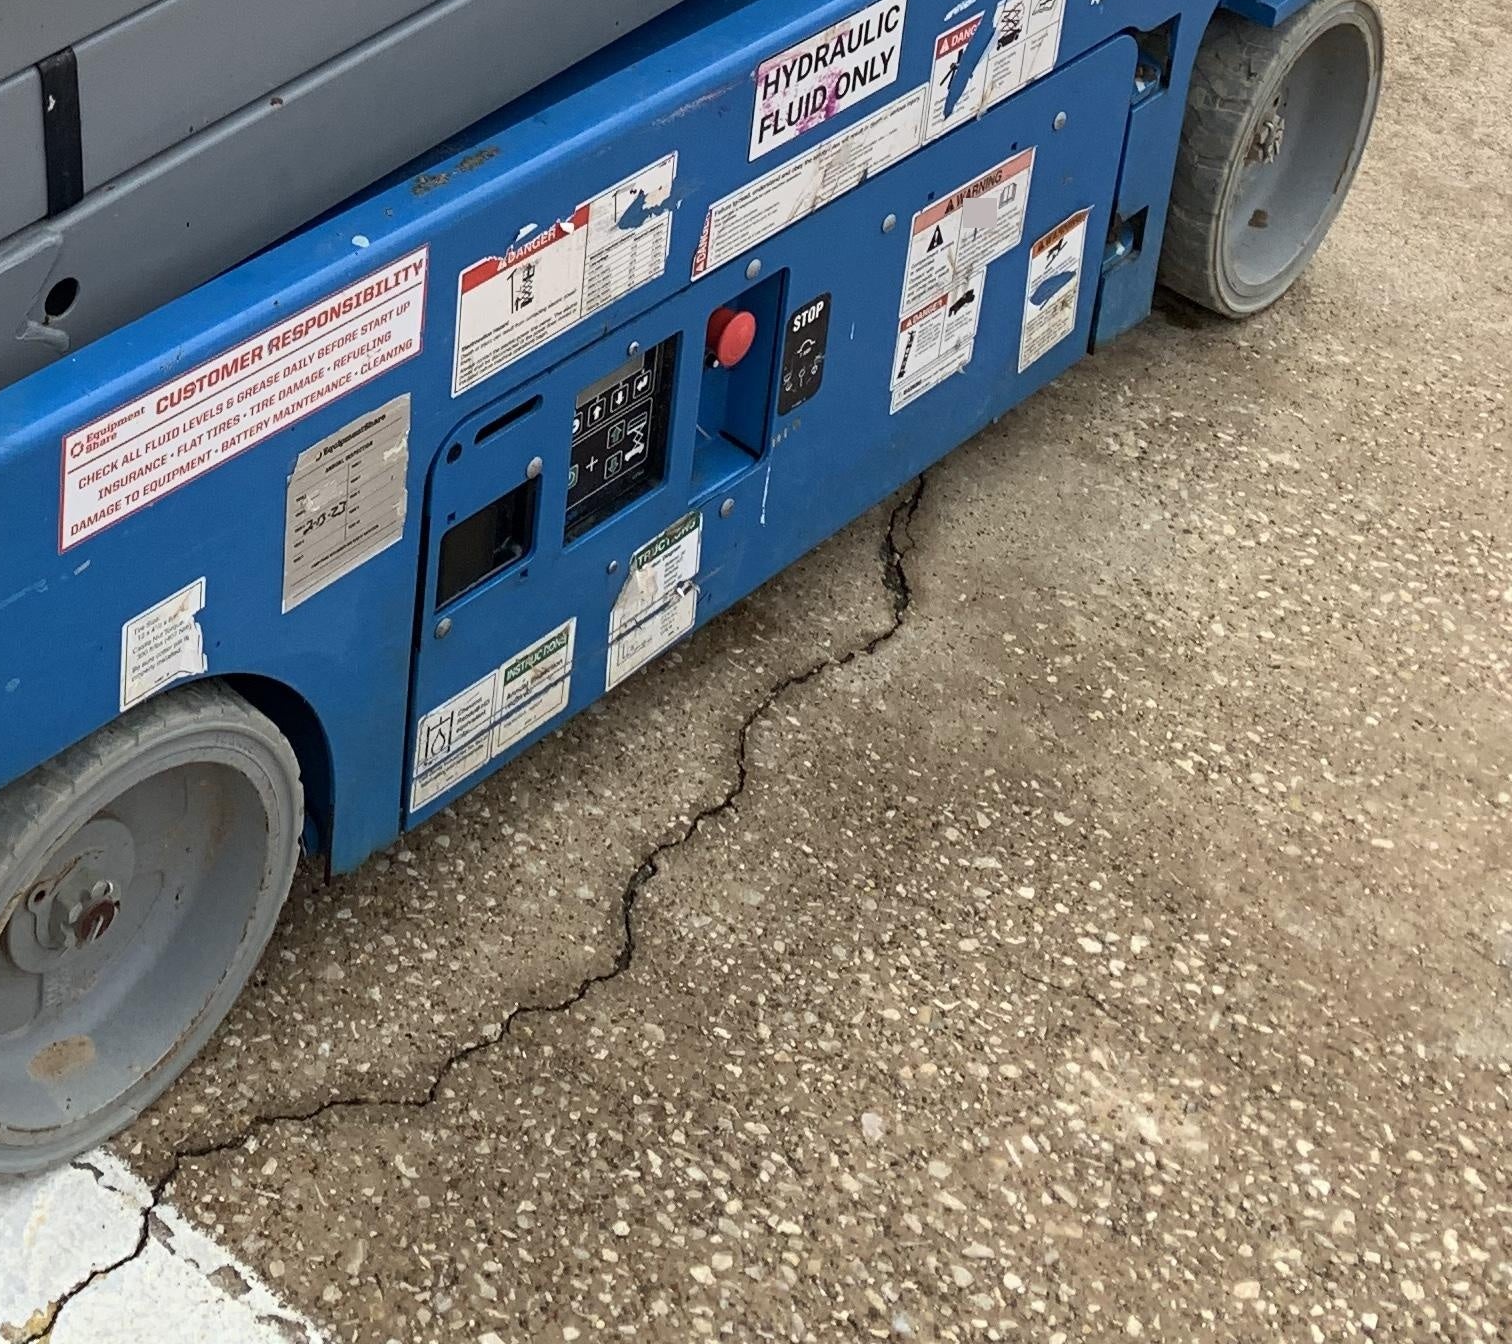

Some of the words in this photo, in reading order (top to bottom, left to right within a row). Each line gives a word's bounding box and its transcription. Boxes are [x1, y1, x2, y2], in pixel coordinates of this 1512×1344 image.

[758, 84, 826, 144] FLUID
[835, 46, 896, 100] ONLY
[762, 4, 901, 101] HYDRAULIC
[508, 227, 557, 263] DANGER
[86, 406, 145, 443] Equipment
[155, 344, 263, 415] CUSTOMER
[269, 258, 423, 355] RESPONSIBILITY
[792, 300, 824, 332] STOP
[70, 499, 121, 536] DAMAGE
[124, 490, 139, 505] TO
[143, 449, 212, 496] EQUIPMENT
[221, 417, 270, 452] BATTERY
[272, 372, 352, 424] MAINTENANCE
[360, 338, 413, 375] CLEANING
[78, 461, 118, 490] CHECK
[121, 449, 142, 467] ALL
[145, 427, 180, 454] FLUID
[183, 404, 223, 433] LEVELS
[237, 371, 279, 403] GREASE
[283, 352, 314, 379] DAILY
[317, 331, 358, 358] BEFORE
[361, 311, 393, 335] START
[395, 301, 410, 316] UP
[85, 432, 117, 454] Share
[98, 454, 167, 500] INSURANCE
[177, 437, 203, 458] FLAT
[206, 415, 240, 445] TIRES
[250, 393, 276, 415] TIRE
[278, 367, 324, 401] DAMAGE
[333, 331, 392, 371] REFUELING
[323, 414, 387, 456] EquipmentShare
